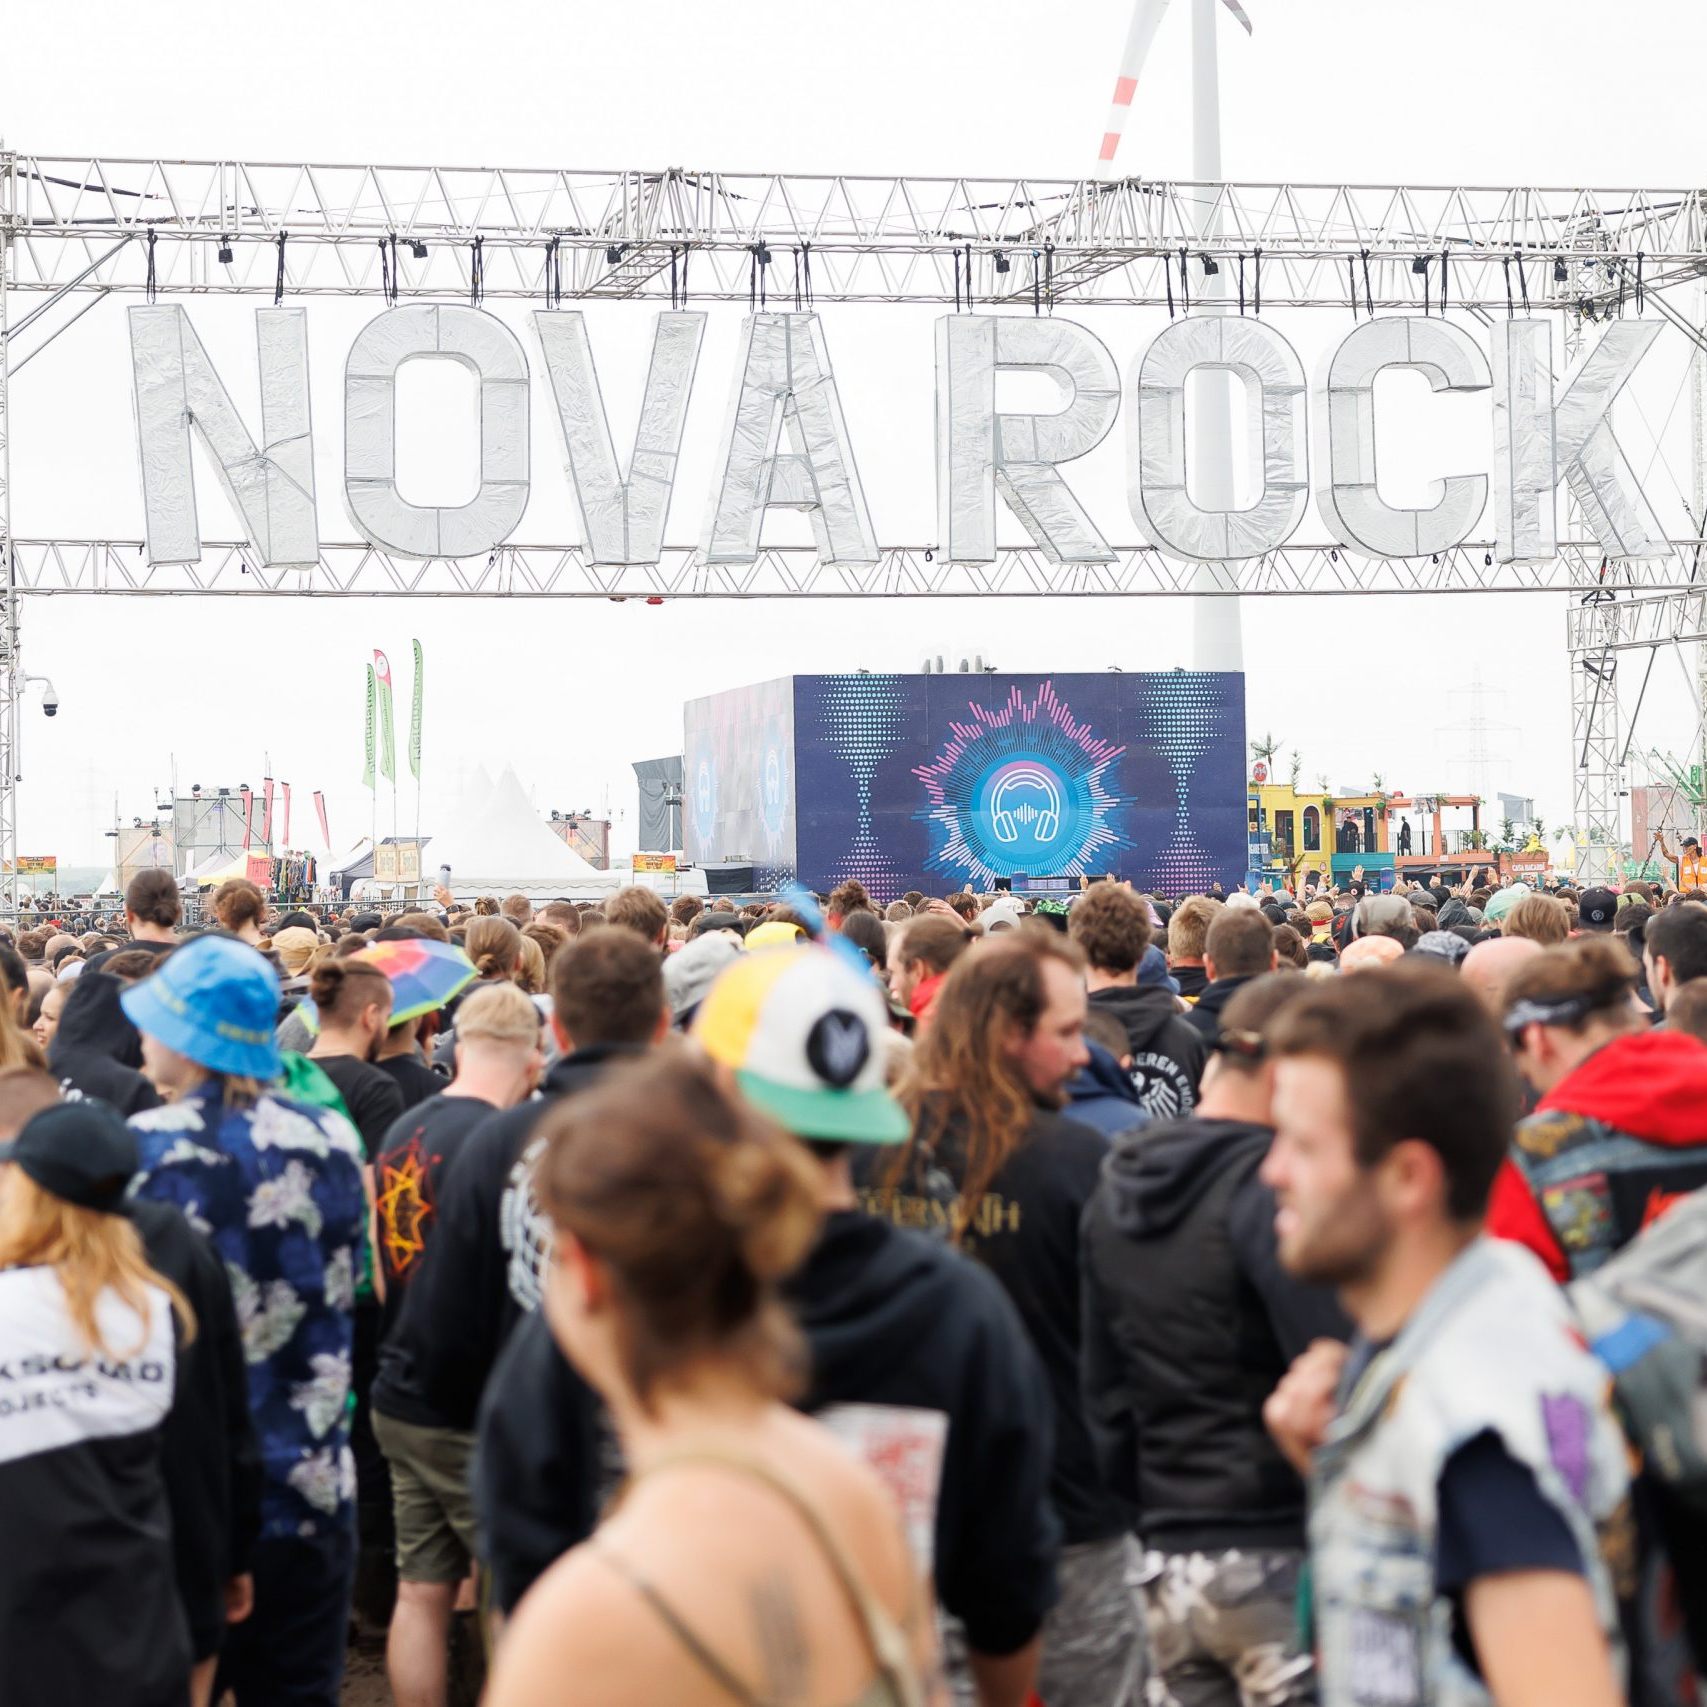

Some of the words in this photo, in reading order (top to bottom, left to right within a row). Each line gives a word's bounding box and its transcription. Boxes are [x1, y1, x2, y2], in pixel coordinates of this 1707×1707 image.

[127, 302, 880, 567] NOVA
[935, 313, 1675, 567] ROCK
[1132, 1051, 1180, 1077] EREN
